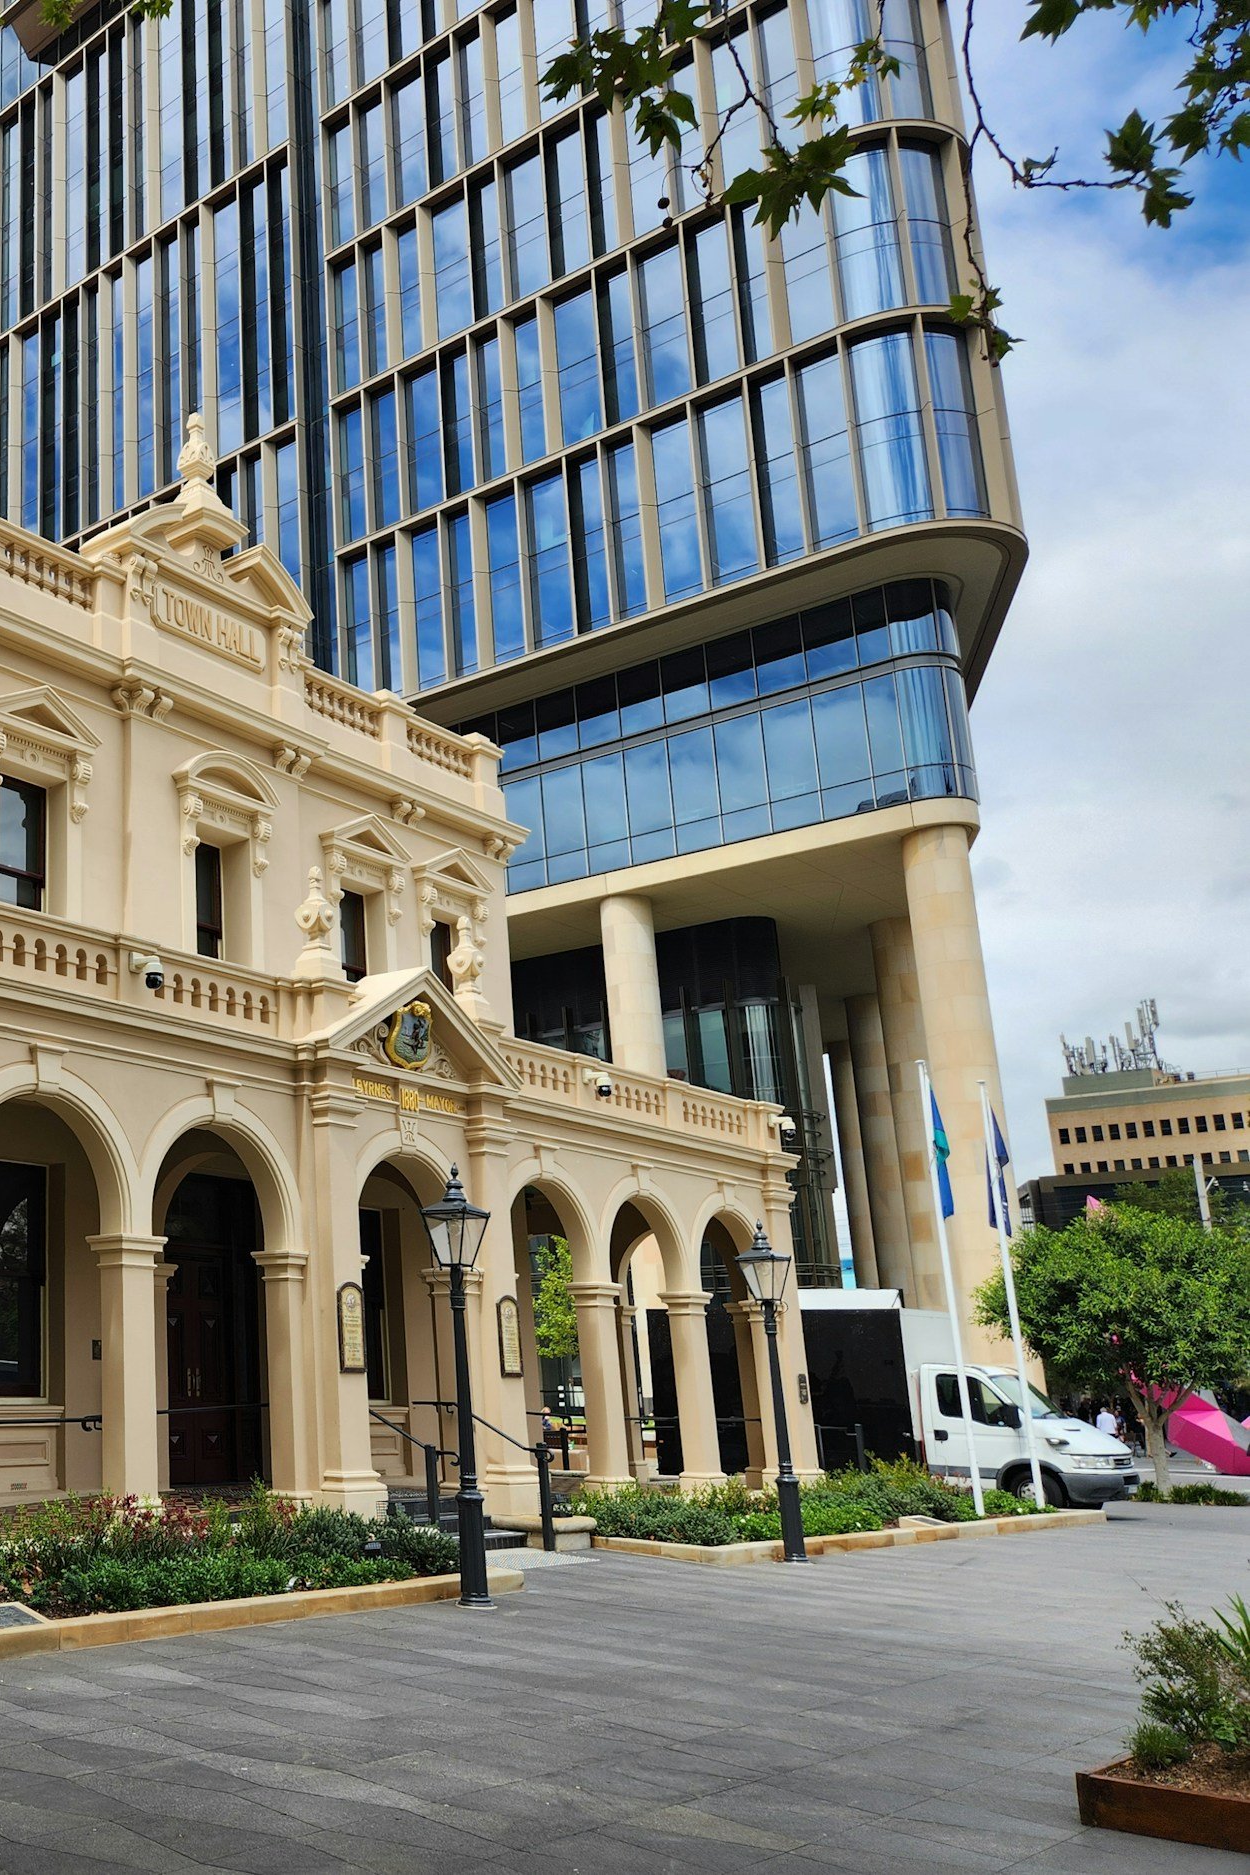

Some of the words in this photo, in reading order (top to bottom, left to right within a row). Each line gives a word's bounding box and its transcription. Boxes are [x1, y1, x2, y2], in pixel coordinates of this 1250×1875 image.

[162, 589, 212, 641] TOWN
[217, 614, 261, 663] HALL
[401, 1088, 419, 1112] 1880
